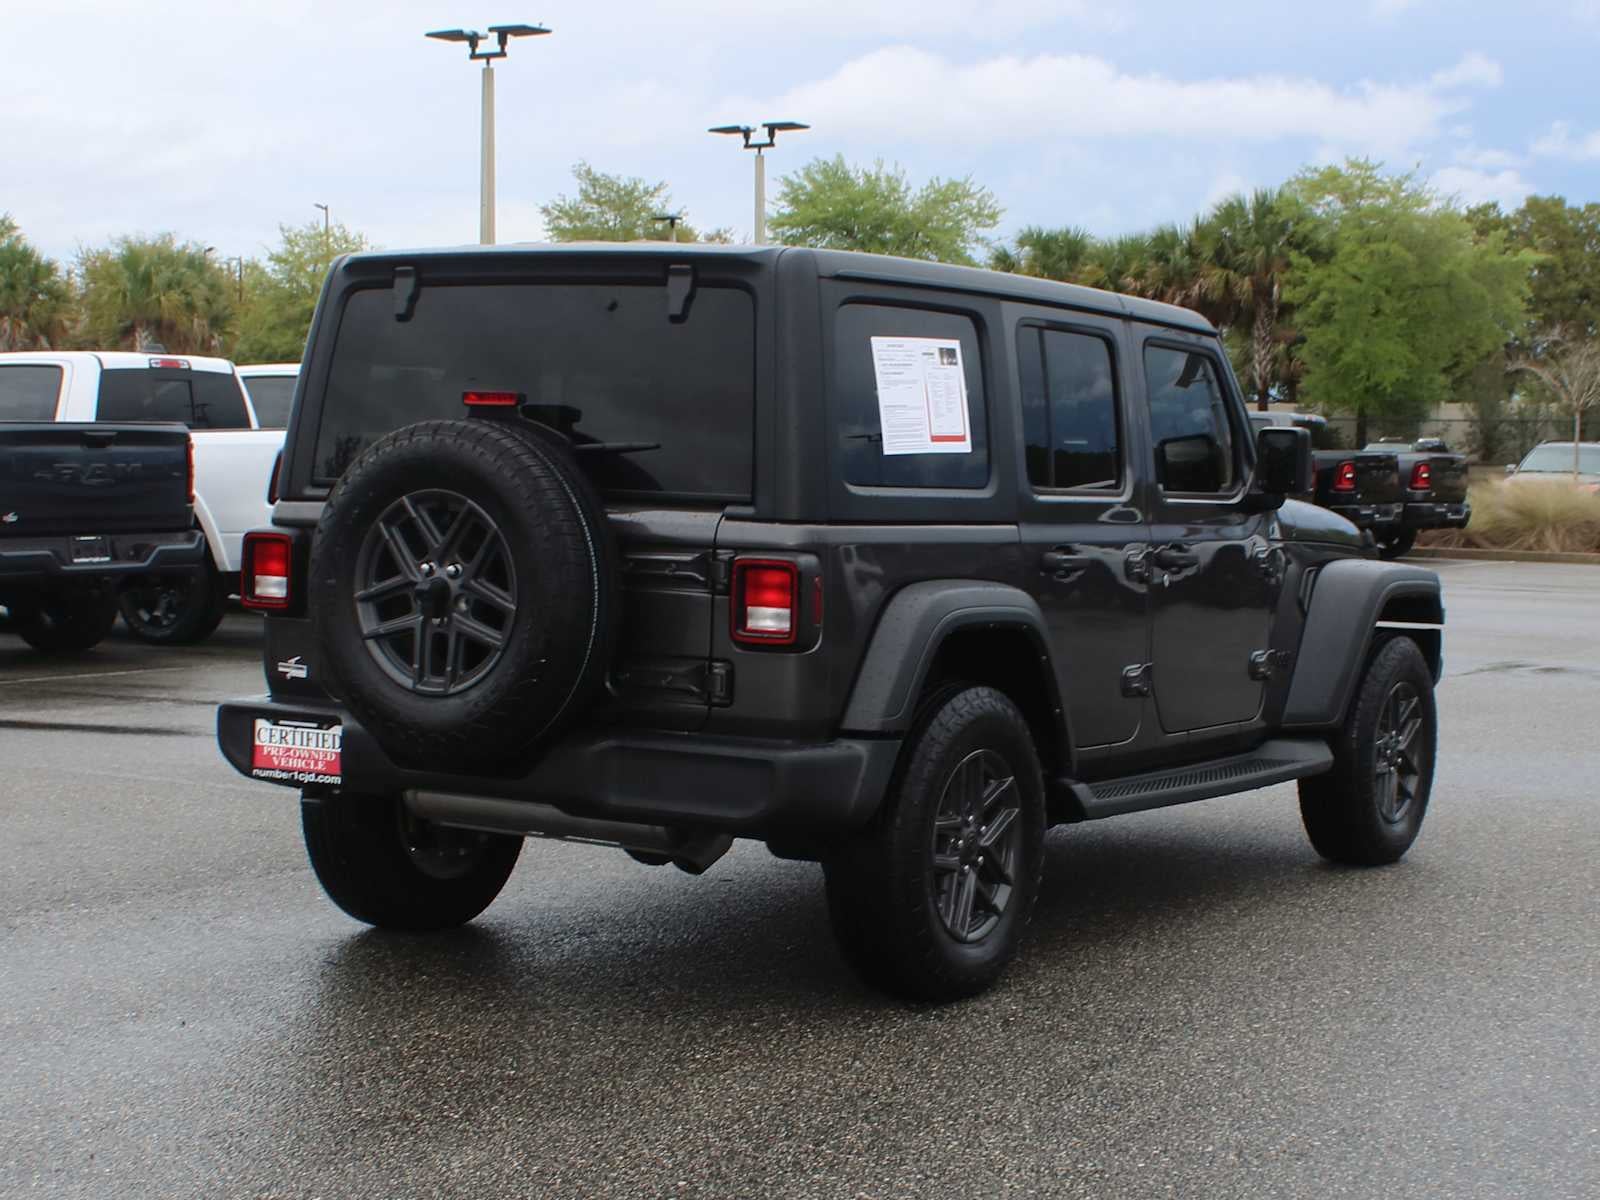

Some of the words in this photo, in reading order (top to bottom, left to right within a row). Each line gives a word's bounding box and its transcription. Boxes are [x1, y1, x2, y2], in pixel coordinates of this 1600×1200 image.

[257, 727, 342, 750] CERTIFIED
[263, 746, 336, 761] PRE-OWNED
[272, 756, 326, 770] VEHICLE
